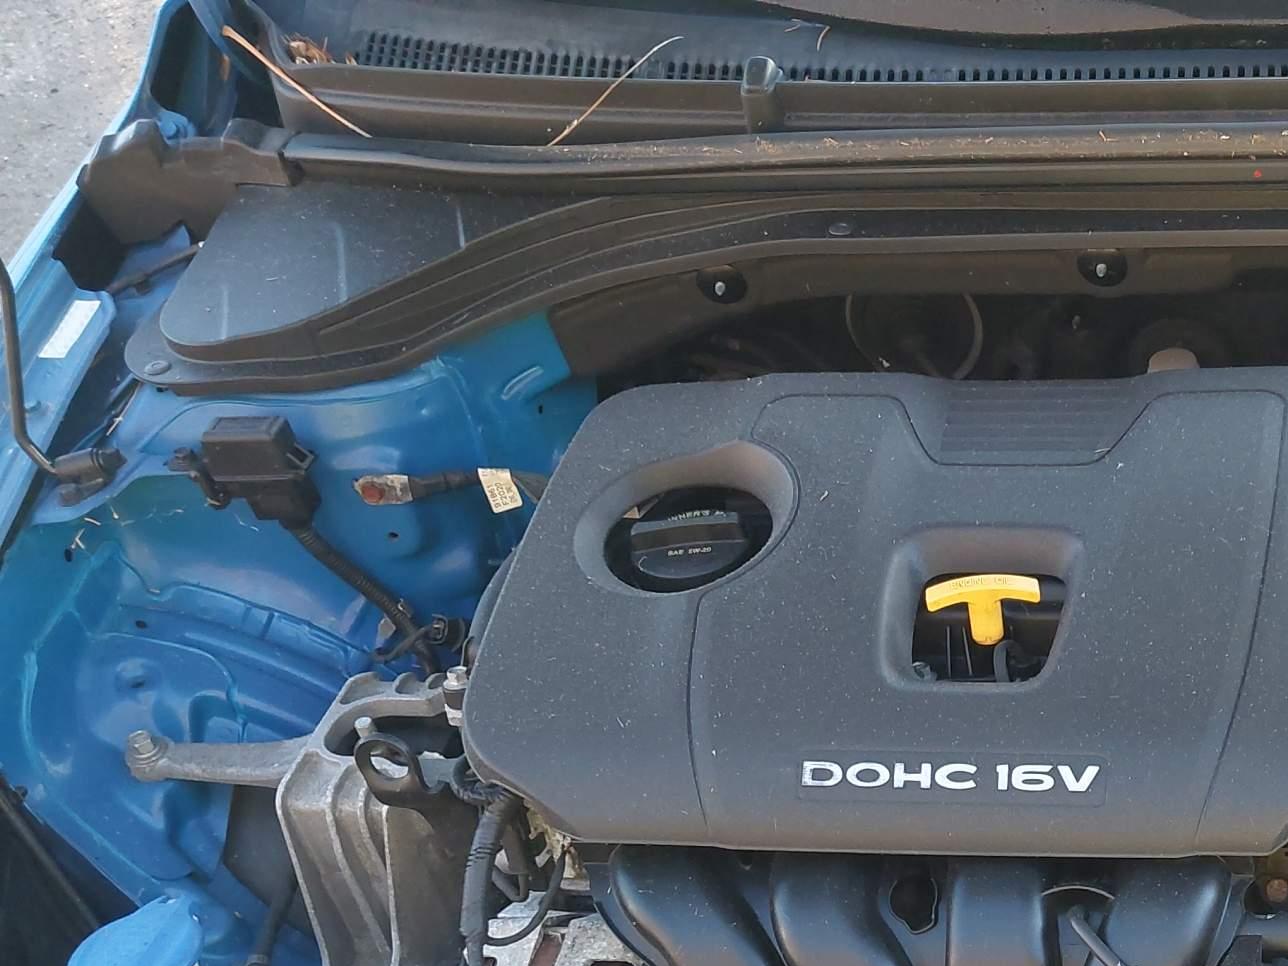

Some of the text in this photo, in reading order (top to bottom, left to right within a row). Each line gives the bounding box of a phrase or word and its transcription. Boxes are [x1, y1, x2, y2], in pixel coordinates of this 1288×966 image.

[667, 549, 685, 557] SAE
[801, 761, 1100, 792] DOHC 16V
